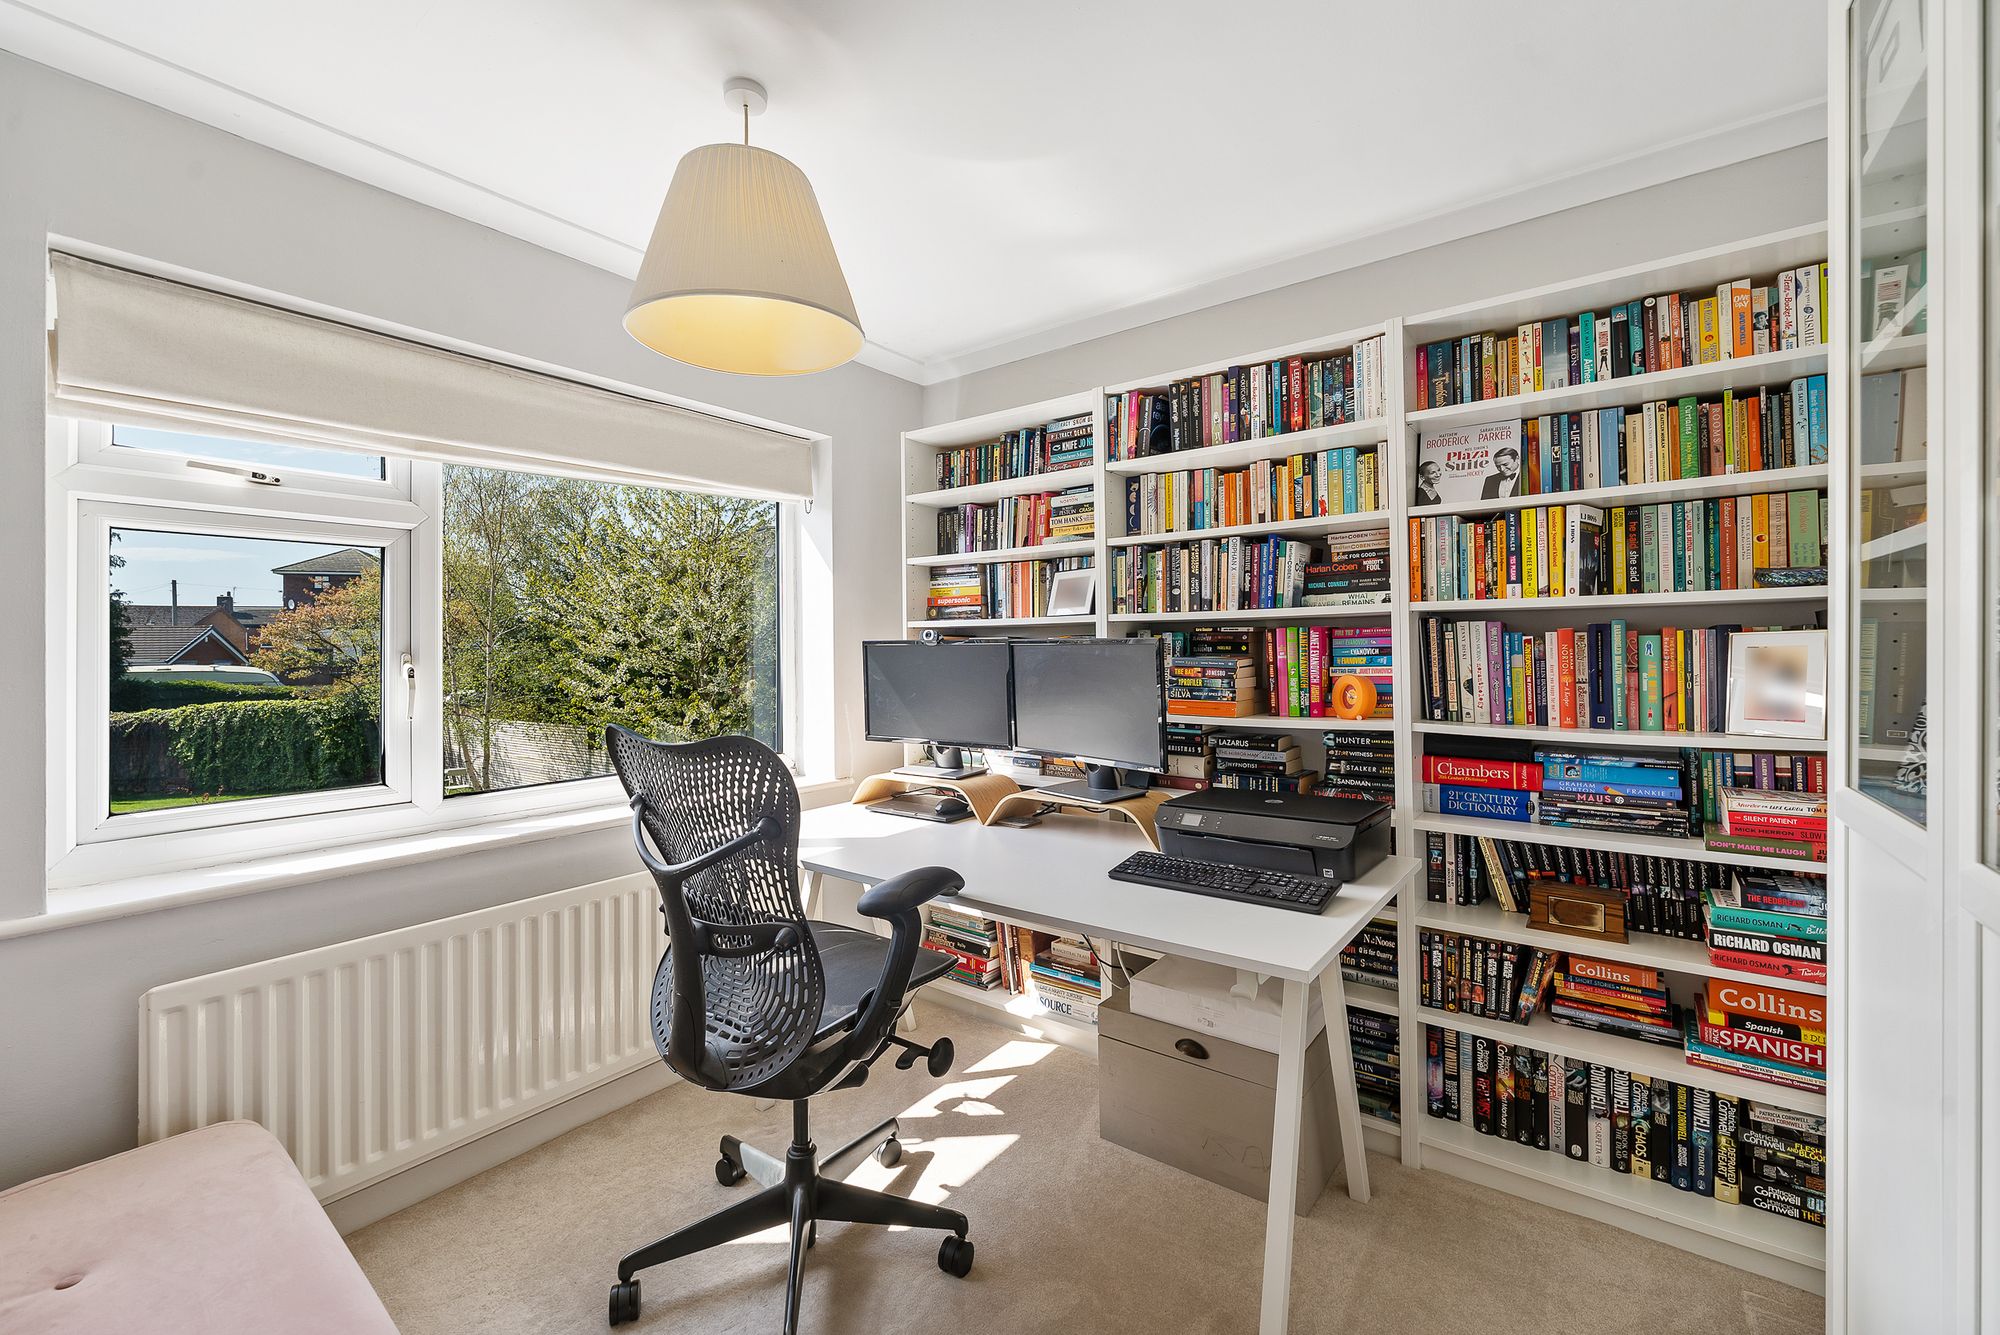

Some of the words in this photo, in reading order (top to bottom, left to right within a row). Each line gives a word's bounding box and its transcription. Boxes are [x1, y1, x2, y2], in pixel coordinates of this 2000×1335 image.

[1712, 408, 1721, 443] ROOMS
[1427, 436, 1469, 449] BRODERICK
[1478, 431, 1511, 443] PARKER
[1062, 441, 1077, 450] KNIFE
[1446, 450, 1488, 461] Plaza
[1445, 459, 1489, 472] Suite
[1064, 516, 1083, 525] HANKS
[1630, 522, 1638, 531] he
[1630, 534, 1638, 549] said
[1645, 531, 1655, 546] Nina
[1630, 551, 1639, 564] she
[1306, 565, 1331, 574] Harlan
[1332, 563, 1358, 572] Coben
[1630, 566, 1639, 582] said
[937, 597, 971, 605] supersonic
[1311, 631, 1319, 648] JANET
[1311, 650, 1319, 683] EVANOVICH
[1219, 738, 1249, 747] LAZARUS
[1336, 737, 1370, 745] HUNTER
[1346, 764, 1377, 773] STALKER
[1438, 762, 1510, 779] Chambers
[1337, 778, 1371, 787] SANDMAN
[1464, 792, 1518, 806] CENTURY
[1577, 793, 1611, 803] MAUS
[1626, 788, 1664, 796] FRANKIE
[1449, 800, 1518, 815] DICTIONARY
[1743, 815, 1767, 823] SILENT
[1770, 816, 1797, 825] PATIENT
[1778, 847, 1806, 856] LAUGH
[1747, 894, 1761, 902] THE
[1763, 895, 1806, 908] REDBREAST
[1752, 919, 1782, 929] OSMAN
[1773, 942, 1821, 960] OSMAN
[1749, 960, 1780, 971] OSMAN
[1575, 963, 1630, 983] Collins
[1040, 996, 1072, 1015] SOURCE
[1719, 988, 1822, 1023] Collins
[1745, 1021, 1783, 1035] Spanish
[1719, 1030, 1822, 1066] SPANISH
[1549, 1065, 1560, 1101] Cornwell
[1590, 1064, 1606, 1110] CORNWELL
[1633, 1083, 1644, 1115] Cornwell
[1553, 1105, 1562, 1140] AUTOPSY
[1718, 1100, 1730, 1136] Cornwell
[1727, 1108, 1736, 1131] Patricia
[1635, 1126, 1646, 1157] CHAOS
[1744, 1134, 1785, 1152] Cornwell
[1795, 1143, 1822, 1154] FLESH
[1718, 1149, 1727, 1177] HEART
[1727, 1148, 1736, 1182] DEPRAVED
[1754, 1185, 1800, 1206] Cornwell
[1753, 1198, 1799, 1218] Cornwell
[1802, 1209, 1820, 1223] THE
